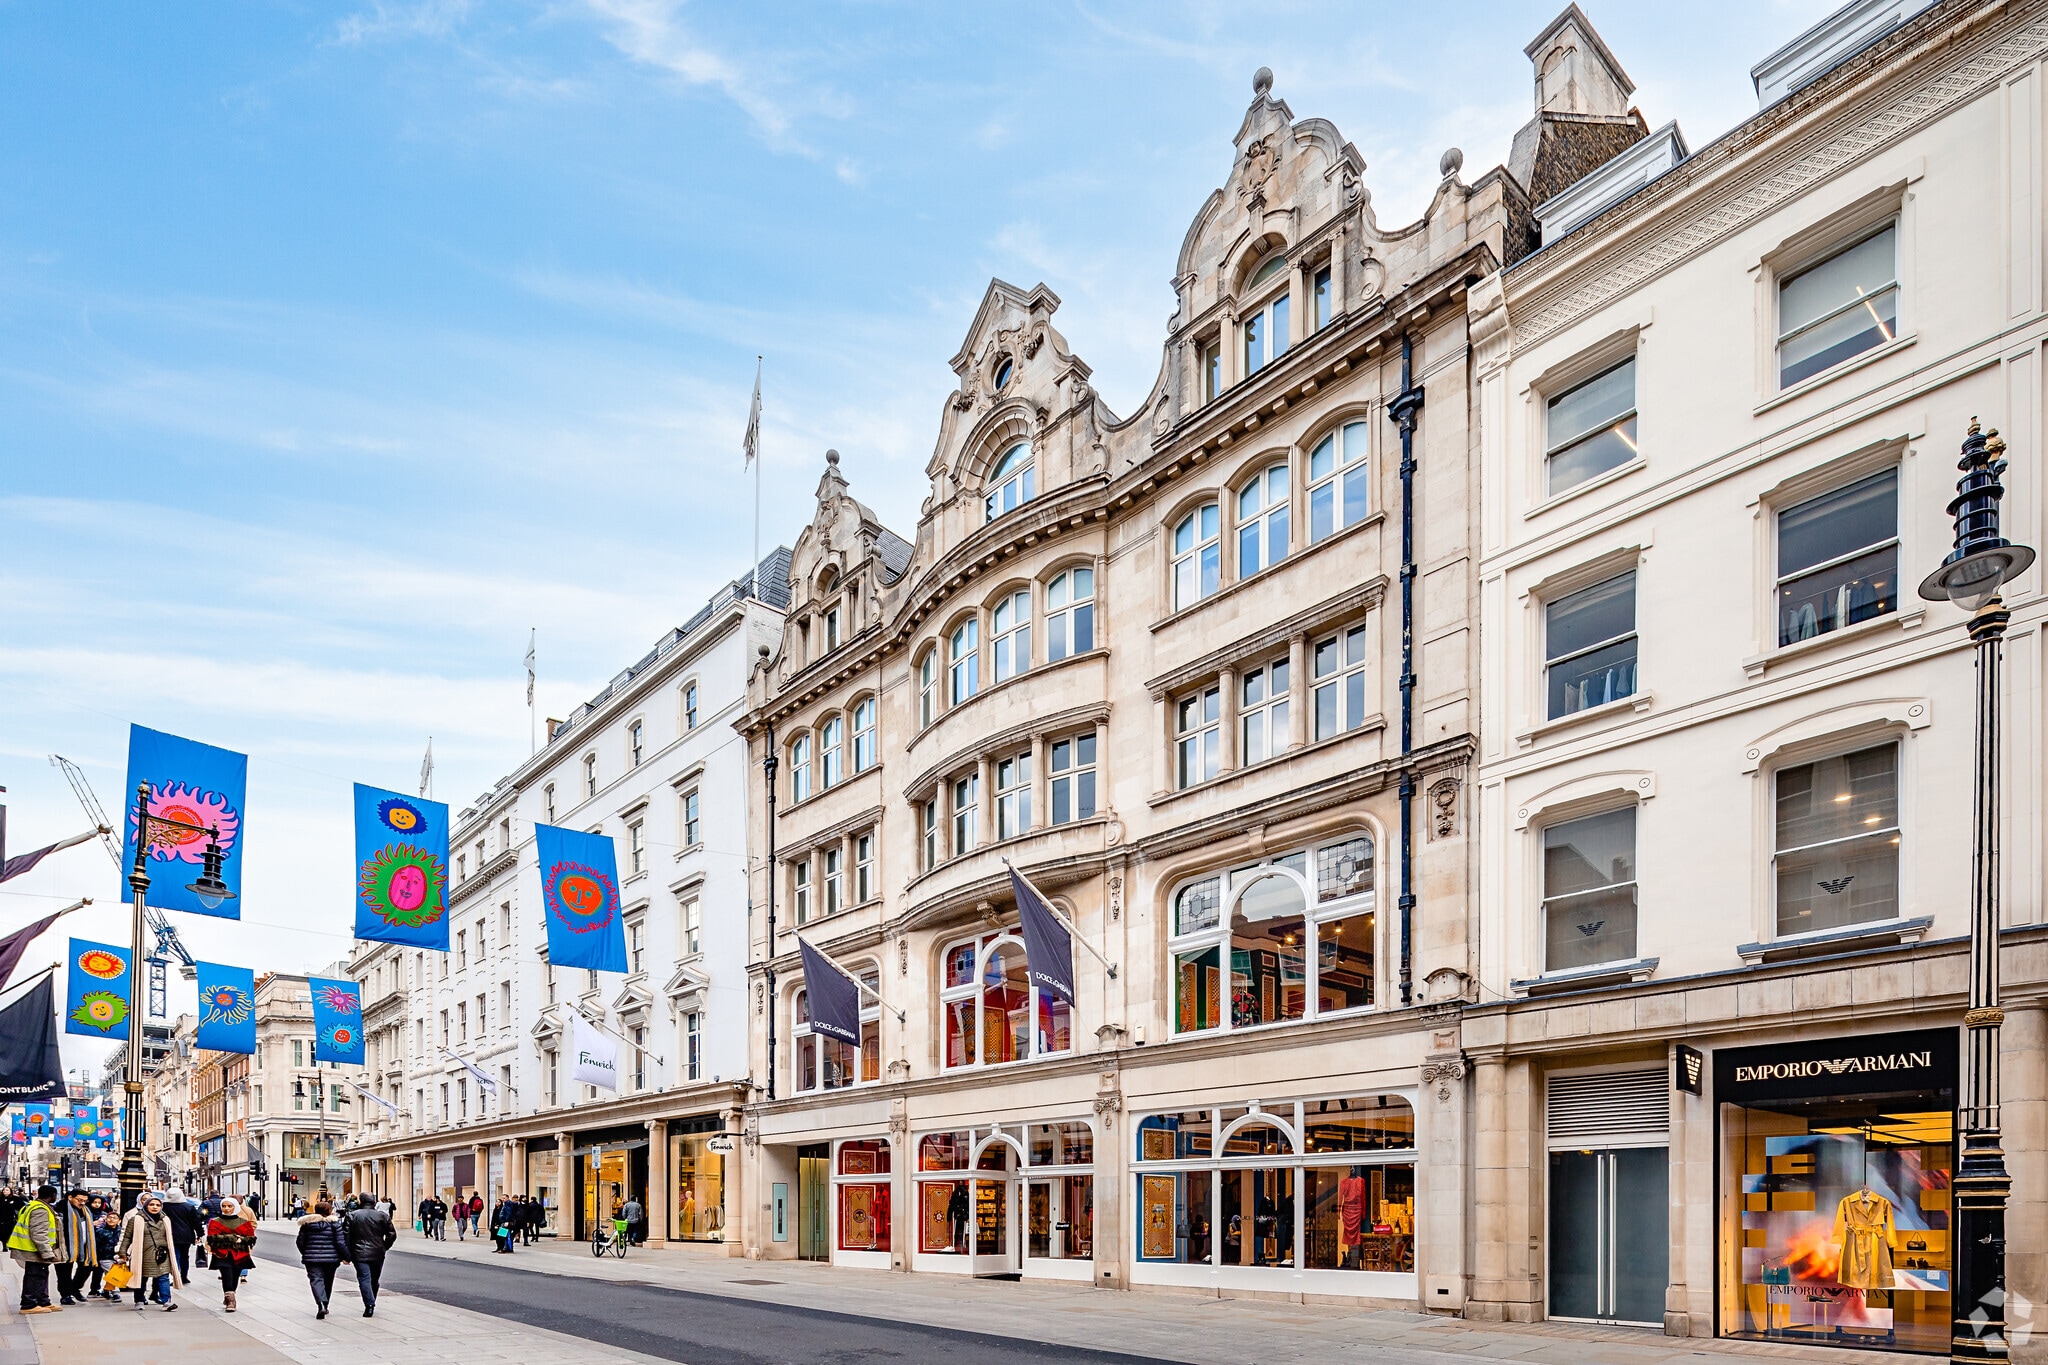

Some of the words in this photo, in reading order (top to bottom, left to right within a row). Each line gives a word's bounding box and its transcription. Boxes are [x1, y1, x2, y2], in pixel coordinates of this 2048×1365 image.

[578, 1051, 616, 1071] Fenwick
[1735, 1060, 1823, 1082] EMPORIO
[1848, 1051, 1932, 1073] ARMANI
[0, 1083, 50, 1094] ONTBLANC
[1769, 1285, 1824, 1297] EMPORIO
